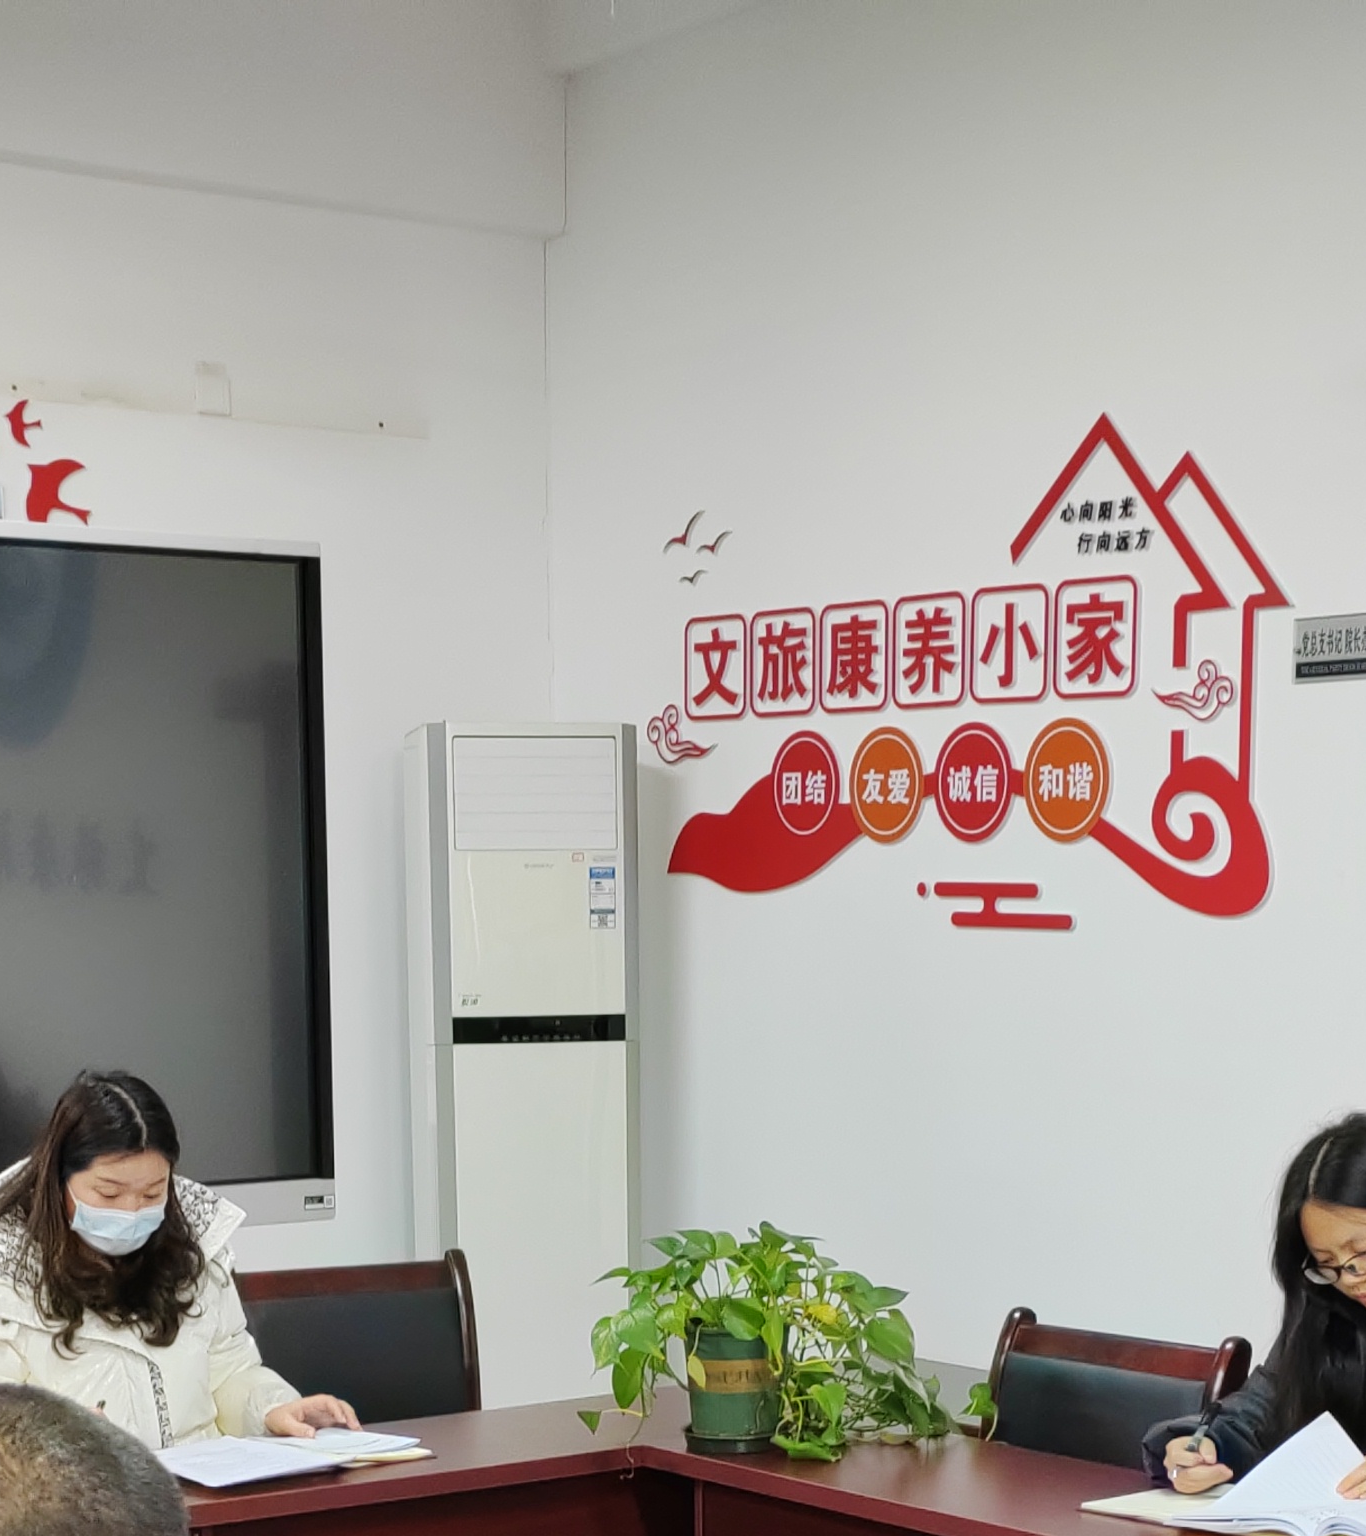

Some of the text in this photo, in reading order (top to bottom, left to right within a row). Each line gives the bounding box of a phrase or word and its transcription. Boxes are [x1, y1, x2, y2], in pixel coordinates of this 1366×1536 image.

[1060, 496, 1133, 523] 心向阳光
[1077, 527, 1150, 554] 行向远方
[692, 592, 1125, 707] 文旅康养小家
[782, 761, 1094, 805] 团结 友爱 诚信 和谐
